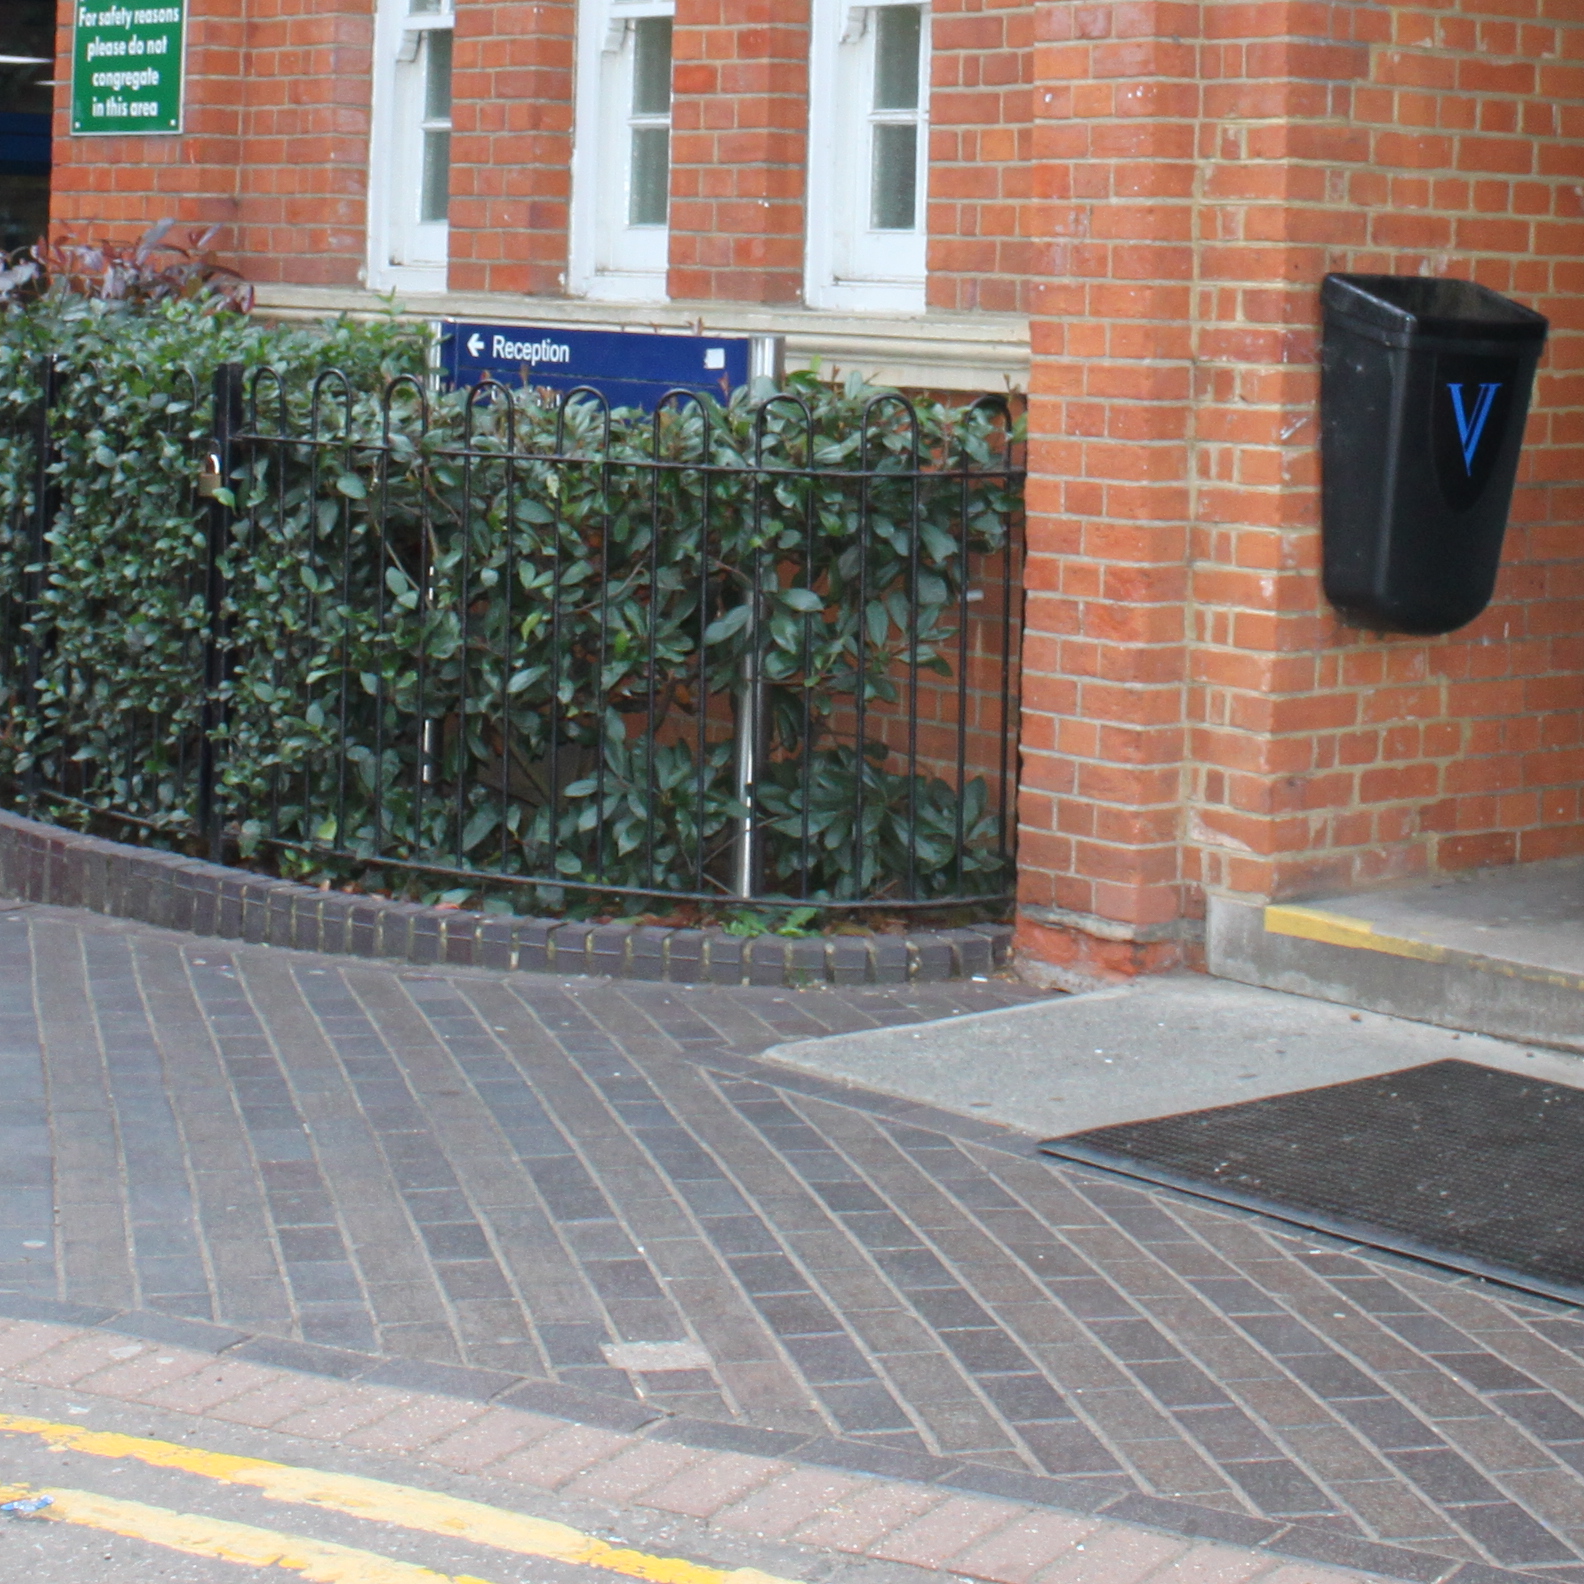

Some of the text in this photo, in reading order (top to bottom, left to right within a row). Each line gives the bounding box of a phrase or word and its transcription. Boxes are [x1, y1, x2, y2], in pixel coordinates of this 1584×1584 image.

[78, 5, 180, 30] For safety reasons
[87, 34, 168, 63] please do not
[91, 67, 160, 91] congregate
[91, 96, 158, 118] in this area
[492, 333, 570, 367] Reception
[1446, 382, 1503, 478] V
